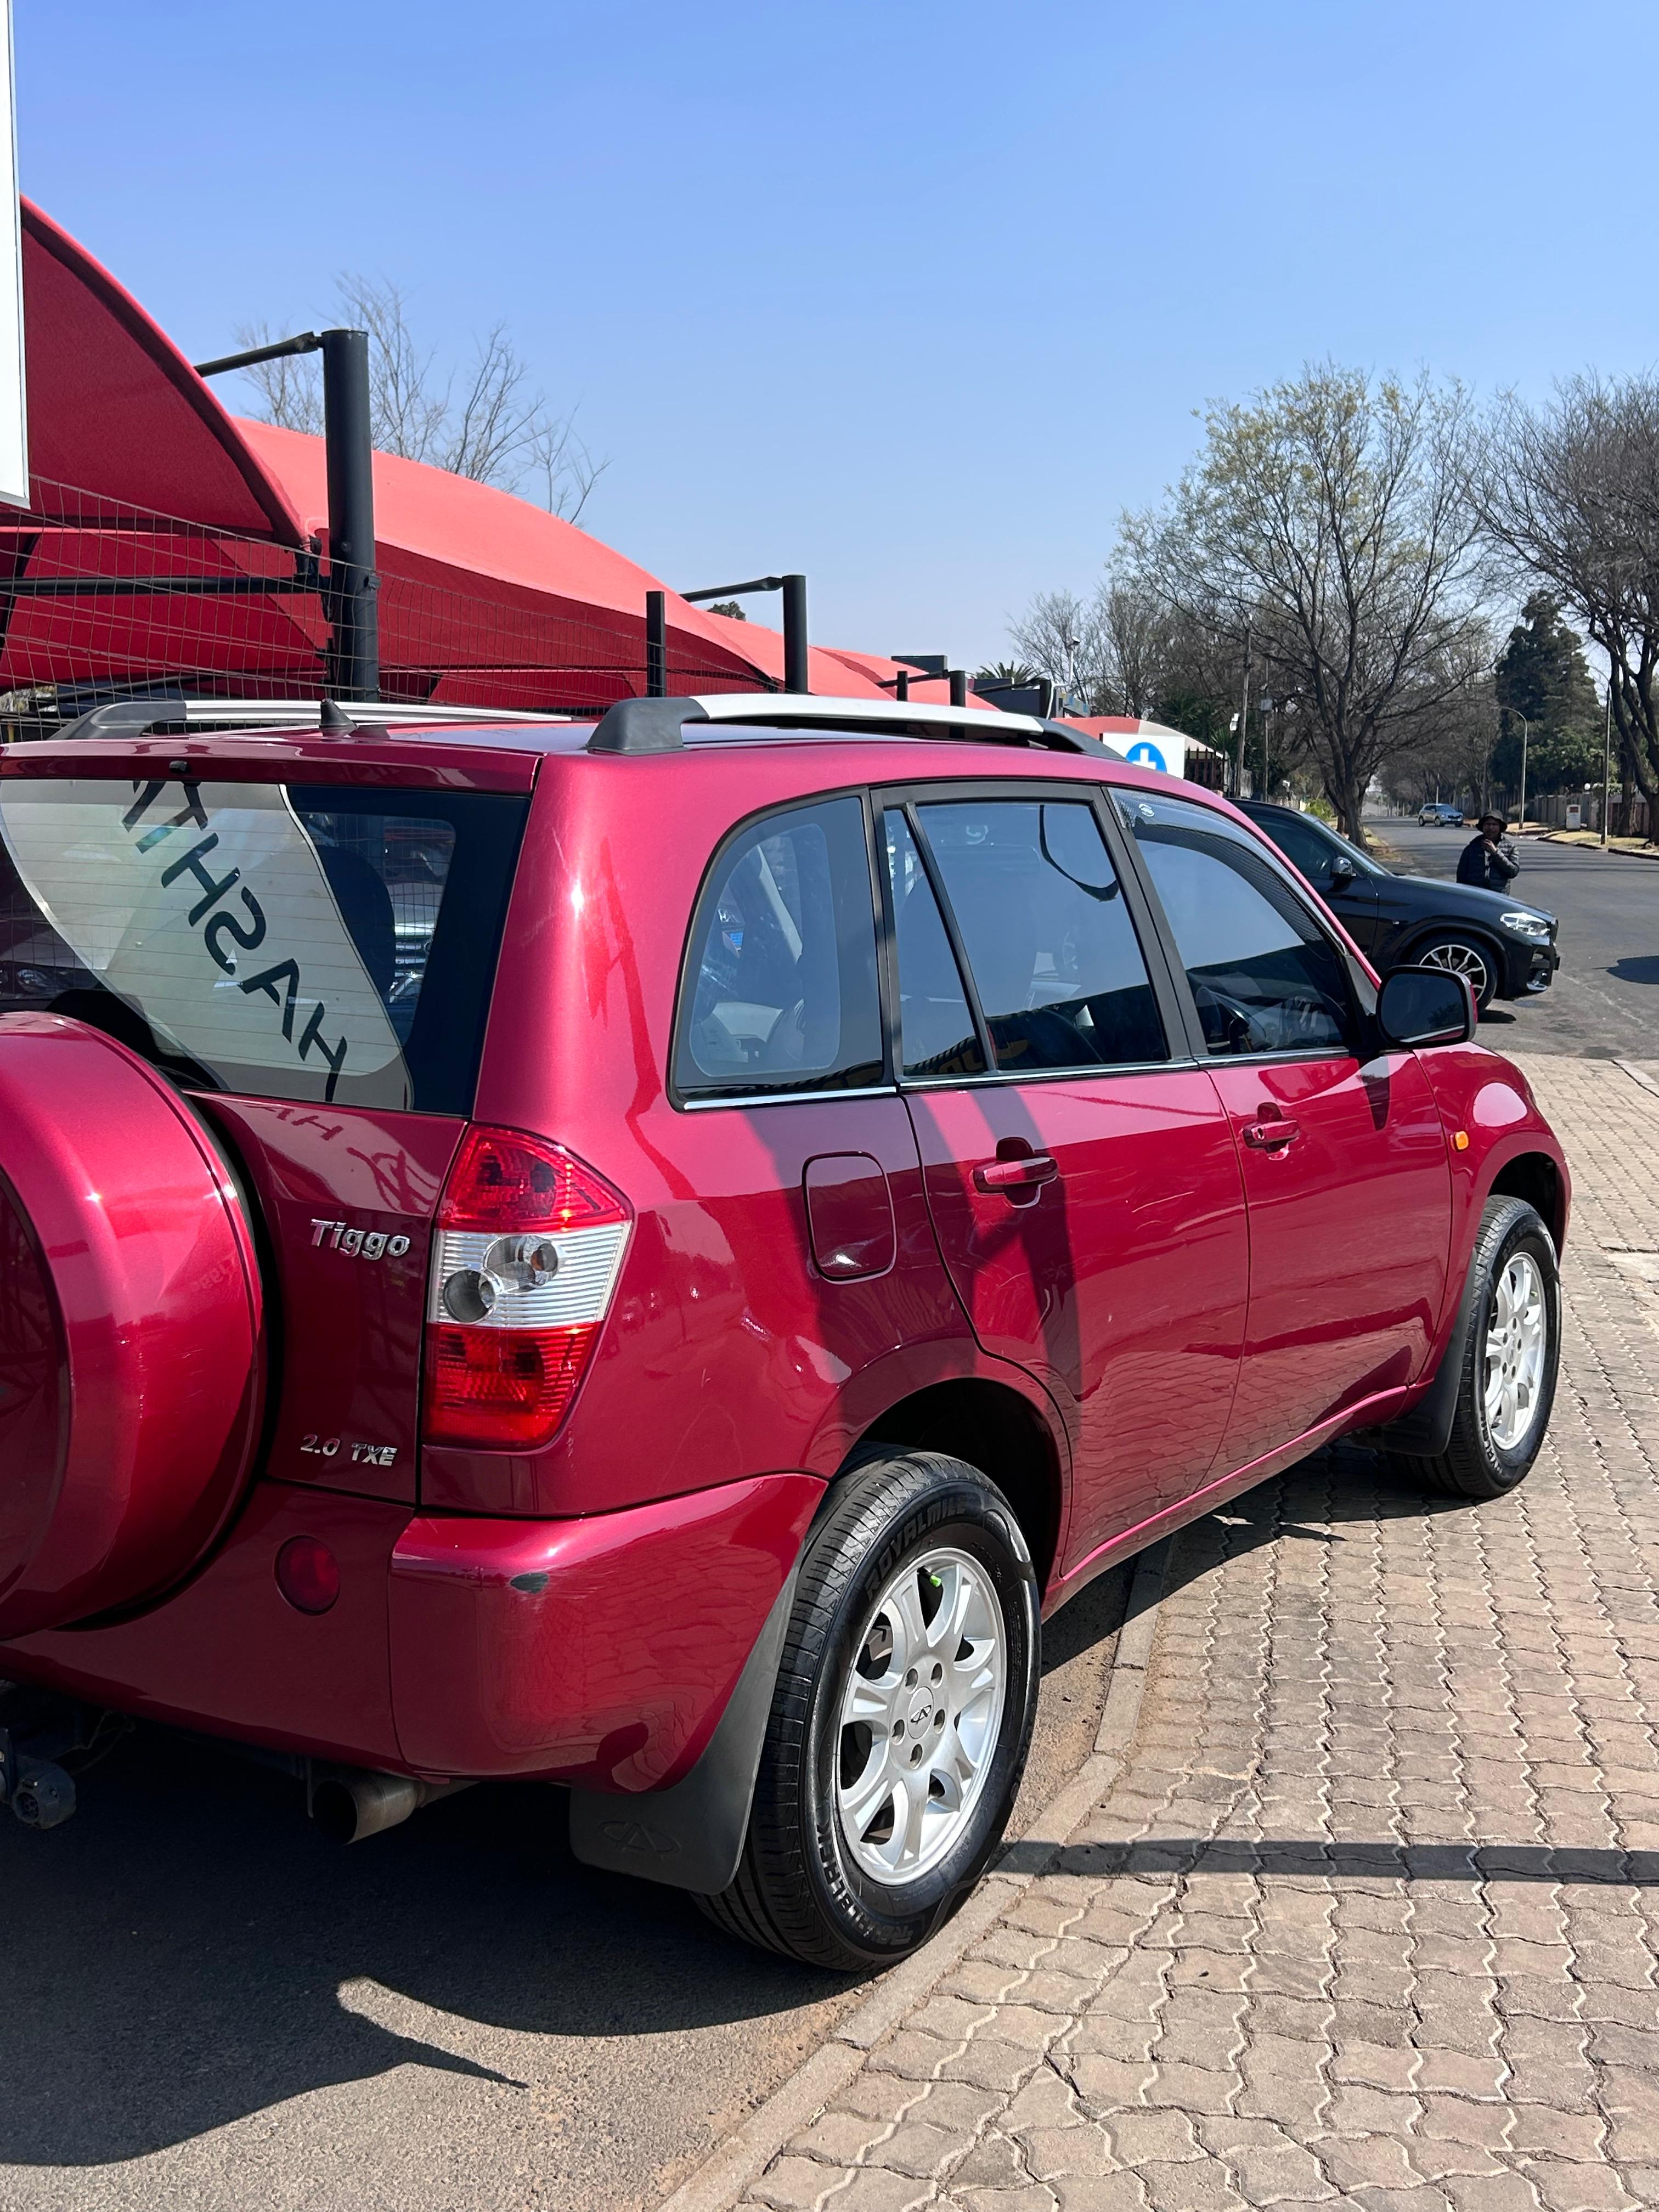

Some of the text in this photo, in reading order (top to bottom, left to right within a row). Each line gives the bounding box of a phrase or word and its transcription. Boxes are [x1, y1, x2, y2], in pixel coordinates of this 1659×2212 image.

[311, 1218, 410, 1260] Tiggo
[300, 1434, 398, 1466] 2.0 TXE
